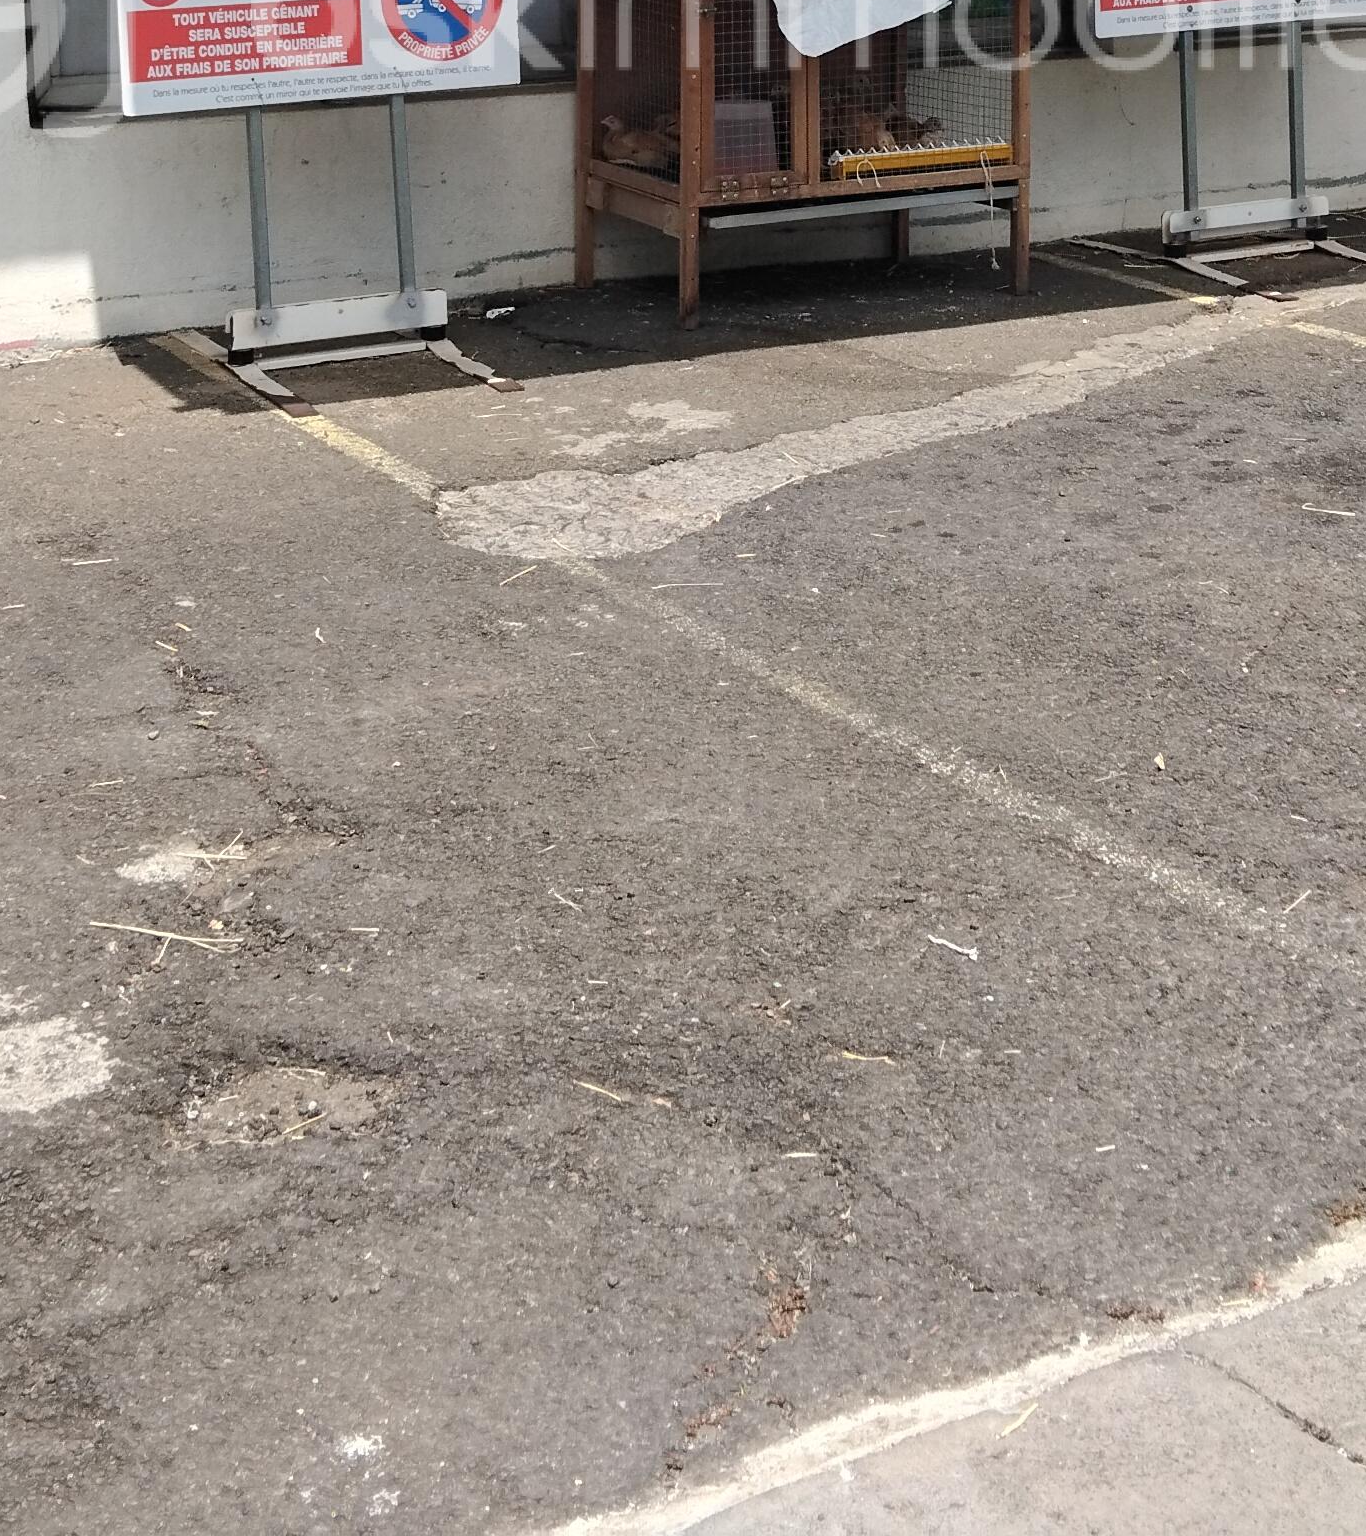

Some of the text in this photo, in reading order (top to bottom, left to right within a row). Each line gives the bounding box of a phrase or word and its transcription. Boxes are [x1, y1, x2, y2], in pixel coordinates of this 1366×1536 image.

[173, 4, 320, 27] TOUT VÉHICULE GÊNANT
[189, 22, 305, 42] SERA SUSCEPTIBLE
[398, 25, 489, 59] PROPRIÉTÉ PRIVÉE
[151, 33, 343, 61] D'ÊTRE CONDUIT EN FOURRIÈRE
[147, 50, 348, 78] AUX FRAIS DE SON PROPRIÉTAIRE
[153, 88, 172, 98] Dans
[172, 88, 179, 96] la
